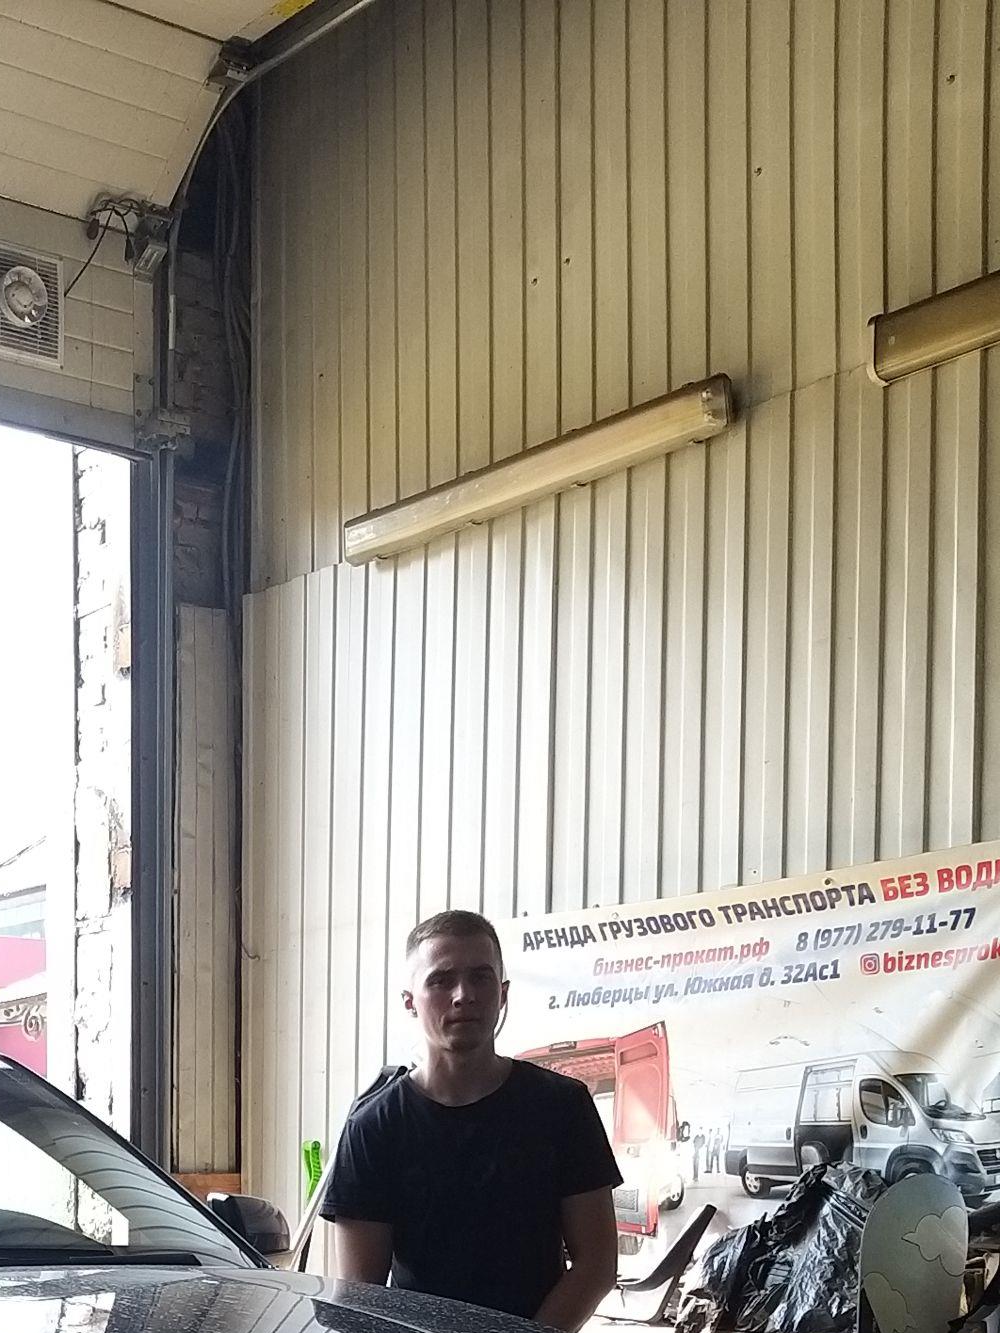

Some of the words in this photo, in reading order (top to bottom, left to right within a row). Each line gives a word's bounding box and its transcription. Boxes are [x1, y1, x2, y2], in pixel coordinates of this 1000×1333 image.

[522, 924, 597, 952] АРЕНДА
[598, 908, 716, 942] ГРУЗОВОГО
[717, 882, 876, 925] ТРАНСПОРТА
[880, 872, 930, 902] БЕЗ
[795, 931, 809, 952] 8
[812, 922, 862, 951] (977)
[865, 907, 976, 942] 279-11-77
[593, 937, 770, 977] бизнес-прокат.рф
[548, 995, 560, 1010] г.
[564, 986, 650, 1008] Люберцы
[652, 983, 679, 1004] ул.
[684, 970, 754, 996] Южная
[758, 967, 775, 987] д.
[780, 959, 841, 985] 32Ас1
